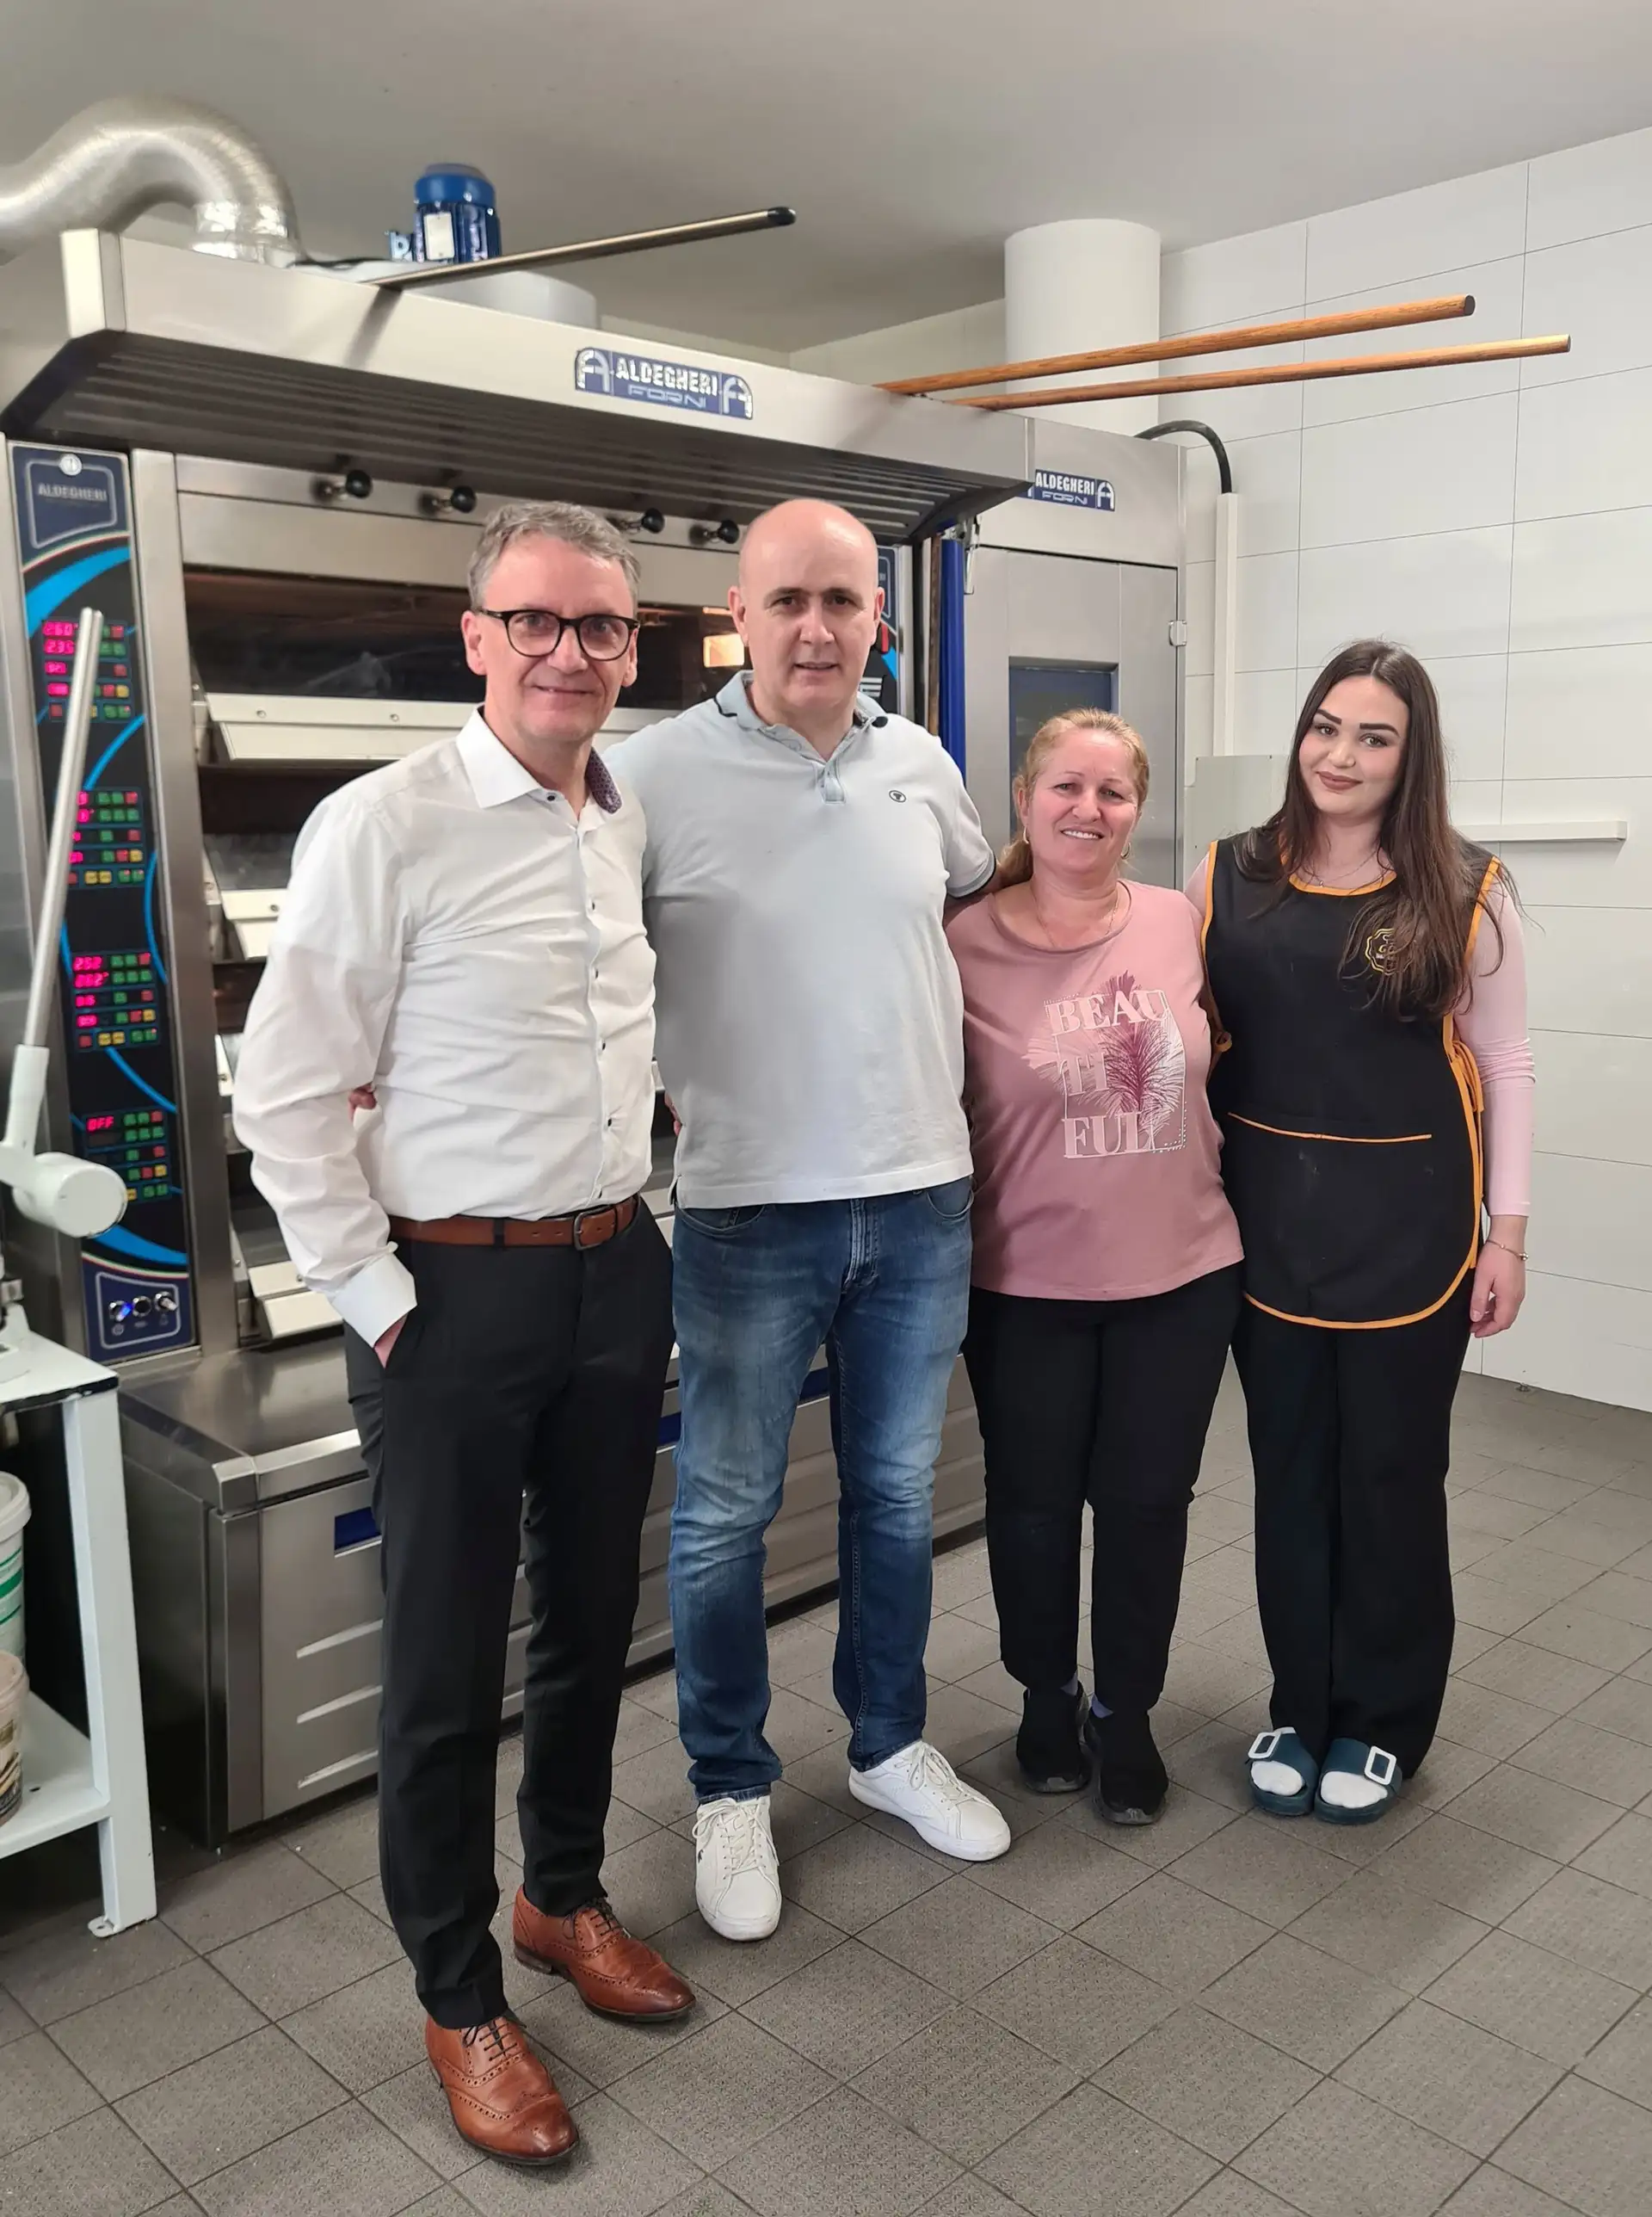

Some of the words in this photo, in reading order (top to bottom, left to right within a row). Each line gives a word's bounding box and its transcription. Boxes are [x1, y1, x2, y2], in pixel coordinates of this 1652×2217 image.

[615, 356, 718, 397] ALDEGHERI
[627, 384, 707, 409] FORNI
[38, 482, 108, 502] ALDEGHERI
[1035, 472, 1094, 496] ALDEGHERI
[1046, 989, 1168, 1036] BEAU
[1062, 1111, 1156, 1159] FUL
